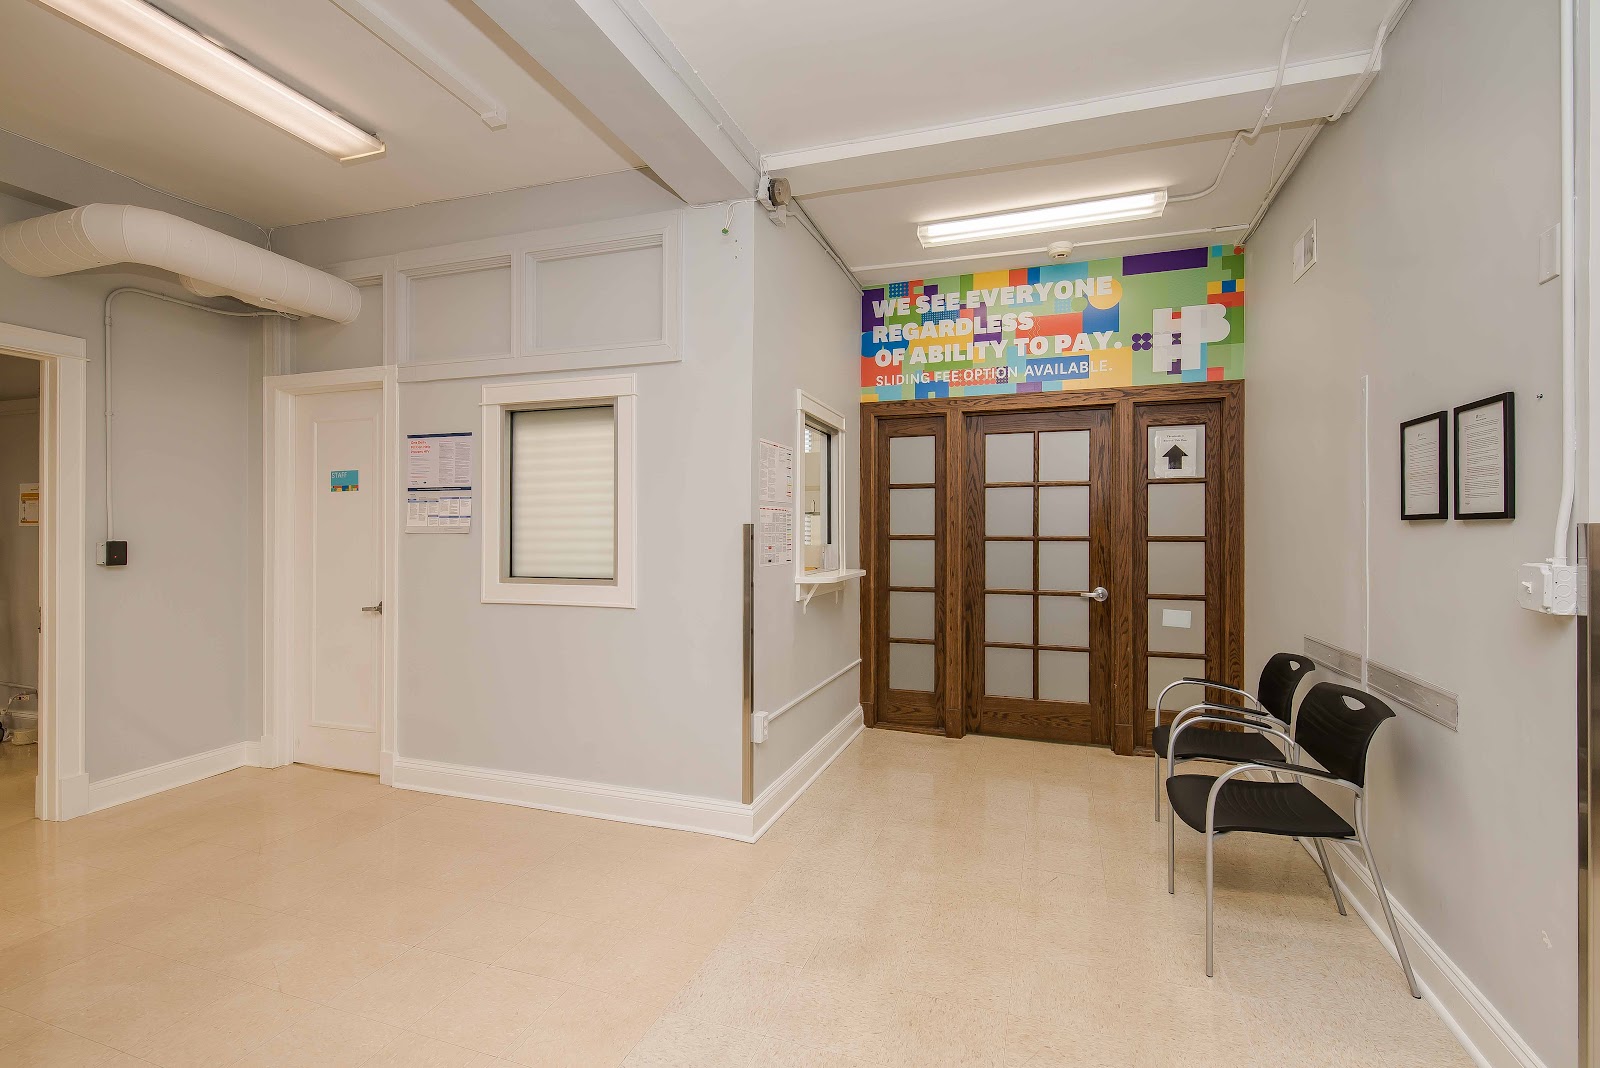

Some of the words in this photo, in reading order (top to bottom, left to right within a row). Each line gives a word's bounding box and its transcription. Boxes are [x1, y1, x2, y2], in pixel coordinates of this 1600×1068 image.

[872, 297, 910, 318] WE
[916, 292, 960, 314] SEE
[966, 276, 1113, 309] EVERYONE
[872, 311, 1034, 344] REGARDLESS
[875, 347, 905, 367] OF
[909, 340, 1008, 365] ABILITY
[1014, 336, 1049, 357] TO
[1055, 330, 1123, 354] PAY.
[875, 372, 931, 387] SLIDING
[935, 370, 961, 383] FEE
[963, 366, 1018, 381] OPTION
[1024, 360, 1113, 377] AVAILABLE.
[331, 471, 348, 479] STAFF
